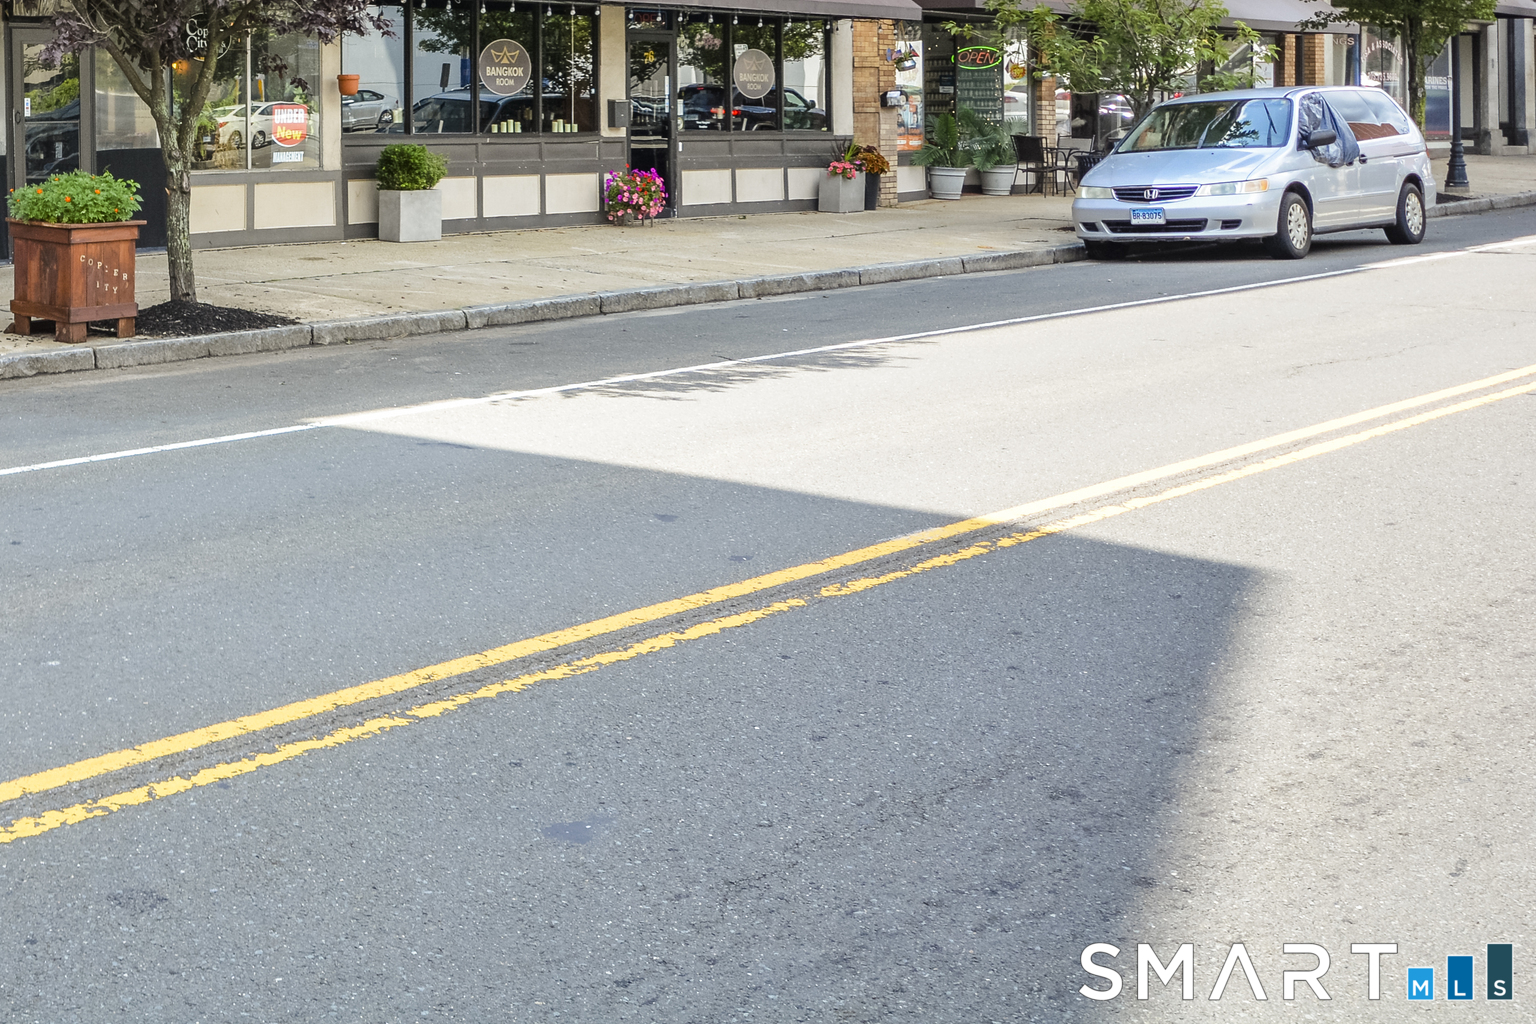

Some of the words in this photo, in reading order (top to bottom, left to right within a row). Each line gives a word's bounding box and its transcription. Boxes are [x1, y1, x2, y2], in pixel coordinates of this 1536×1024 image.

[186, 18, 209, 38] Cop
[644, 51, 655, 64] 76
[958, 51, 996, 64] OPEN
[486, 67, 524, 77] BANGKOK
[739, 73, 769, 82] BANGKOK
[496, 78, 515, 86] ROOM
[1425, 77, 1448, 85] ARINES
[275, 109, 304, 123] UNDER
[277, 126, 303, 140] New
[273, 151, 304, 163] MANAGEMENT
